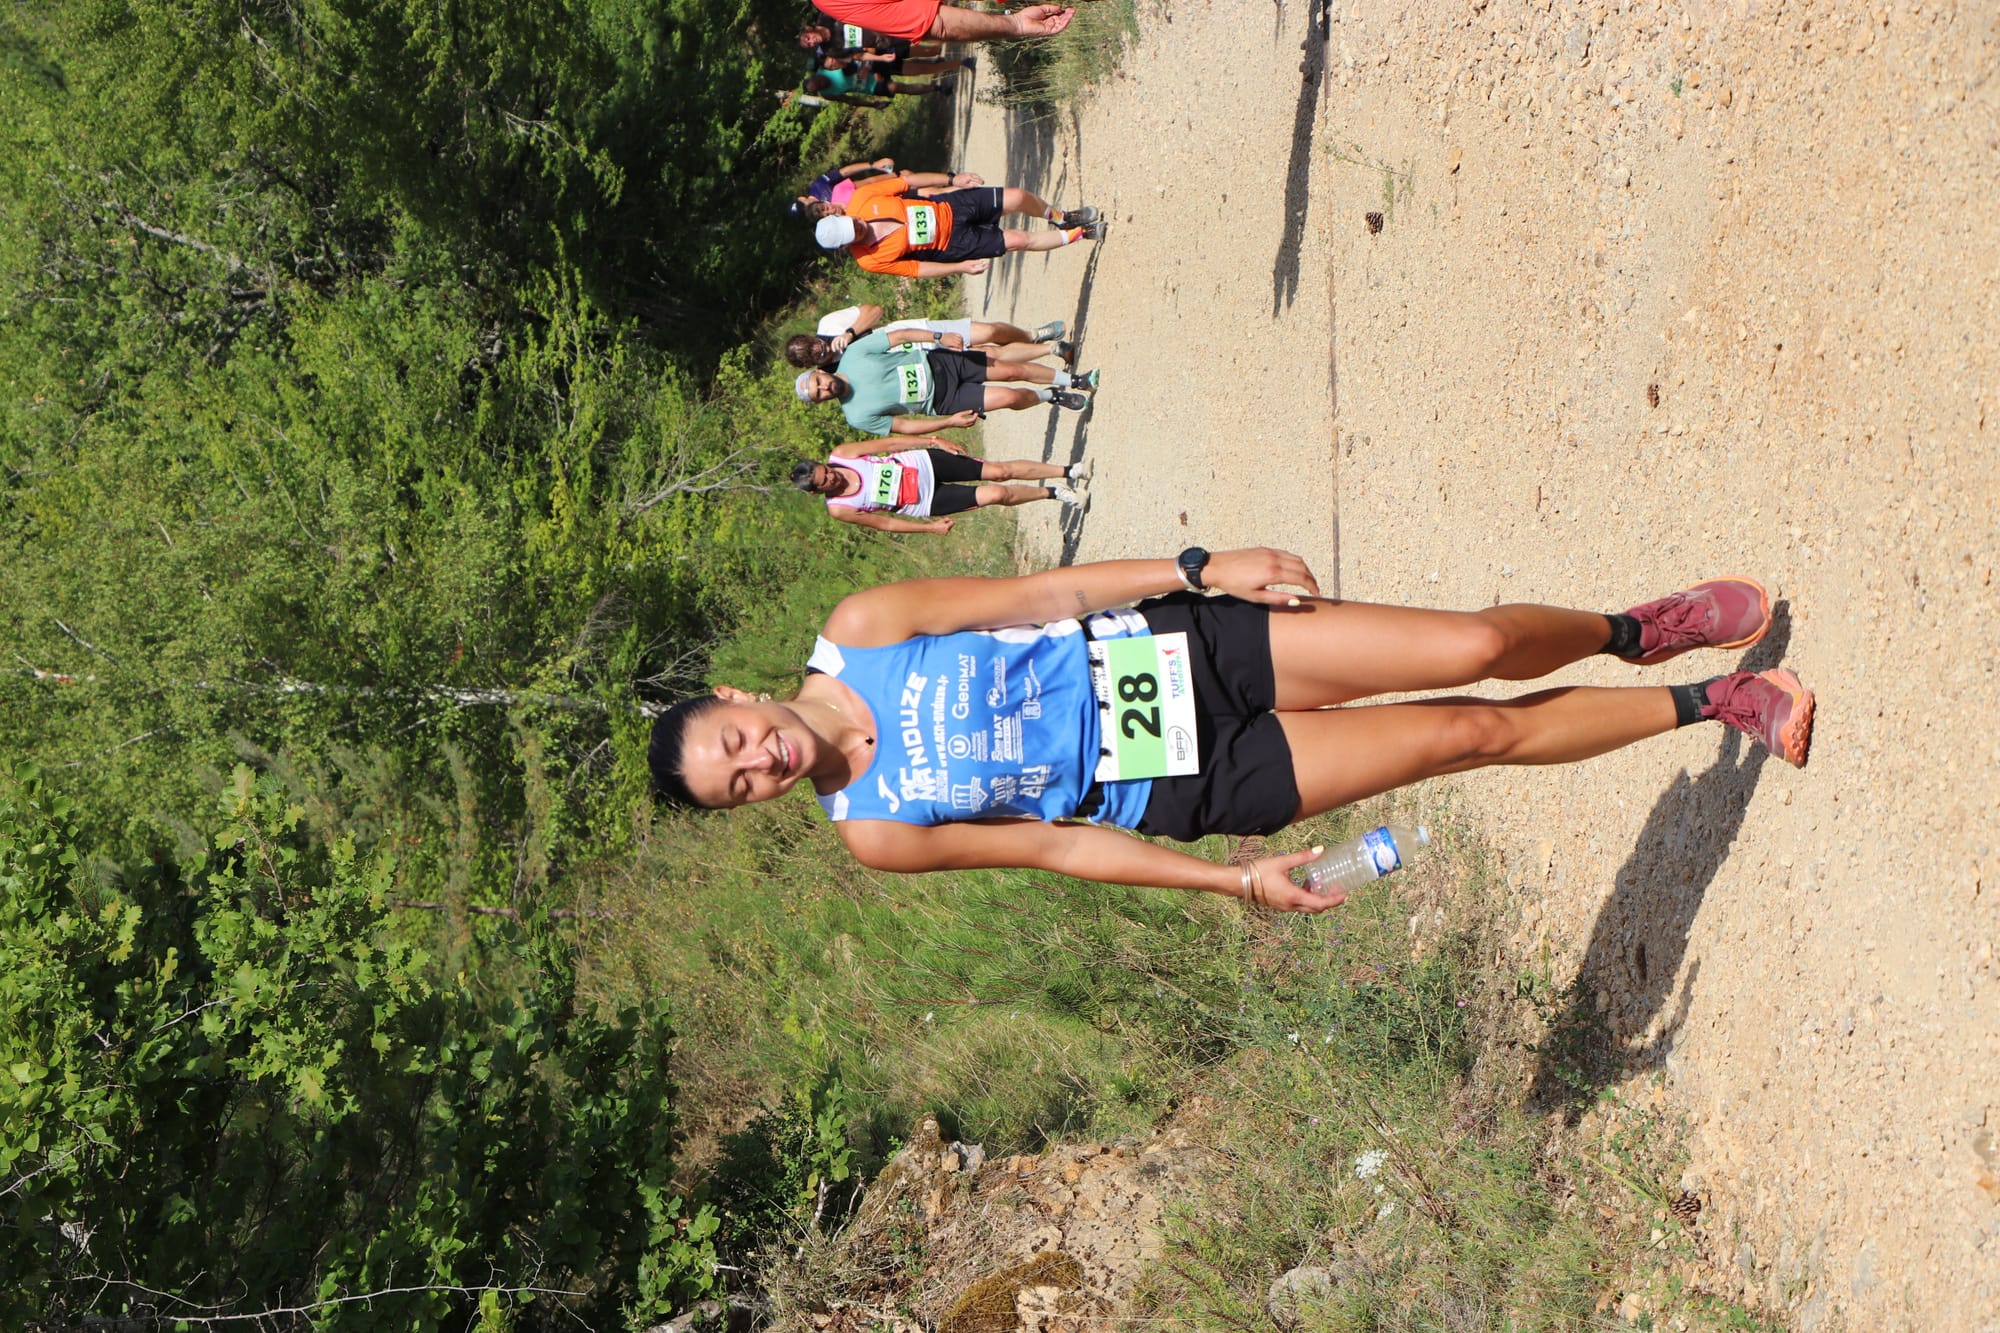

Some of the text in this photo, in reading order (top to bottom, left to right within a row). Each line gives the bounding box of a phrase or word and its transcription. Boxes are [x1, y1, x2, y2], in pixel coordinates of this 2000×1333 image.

[916, 210, 928, 238] 133
[906, 369, 918, 397] 132
[878, 469, 892, 496] 176
[1168, 659, 1180, 699] TUFF'S
[1118, 672, 1161, 739] 28
[1176, 730, 1186, 760] BFP
